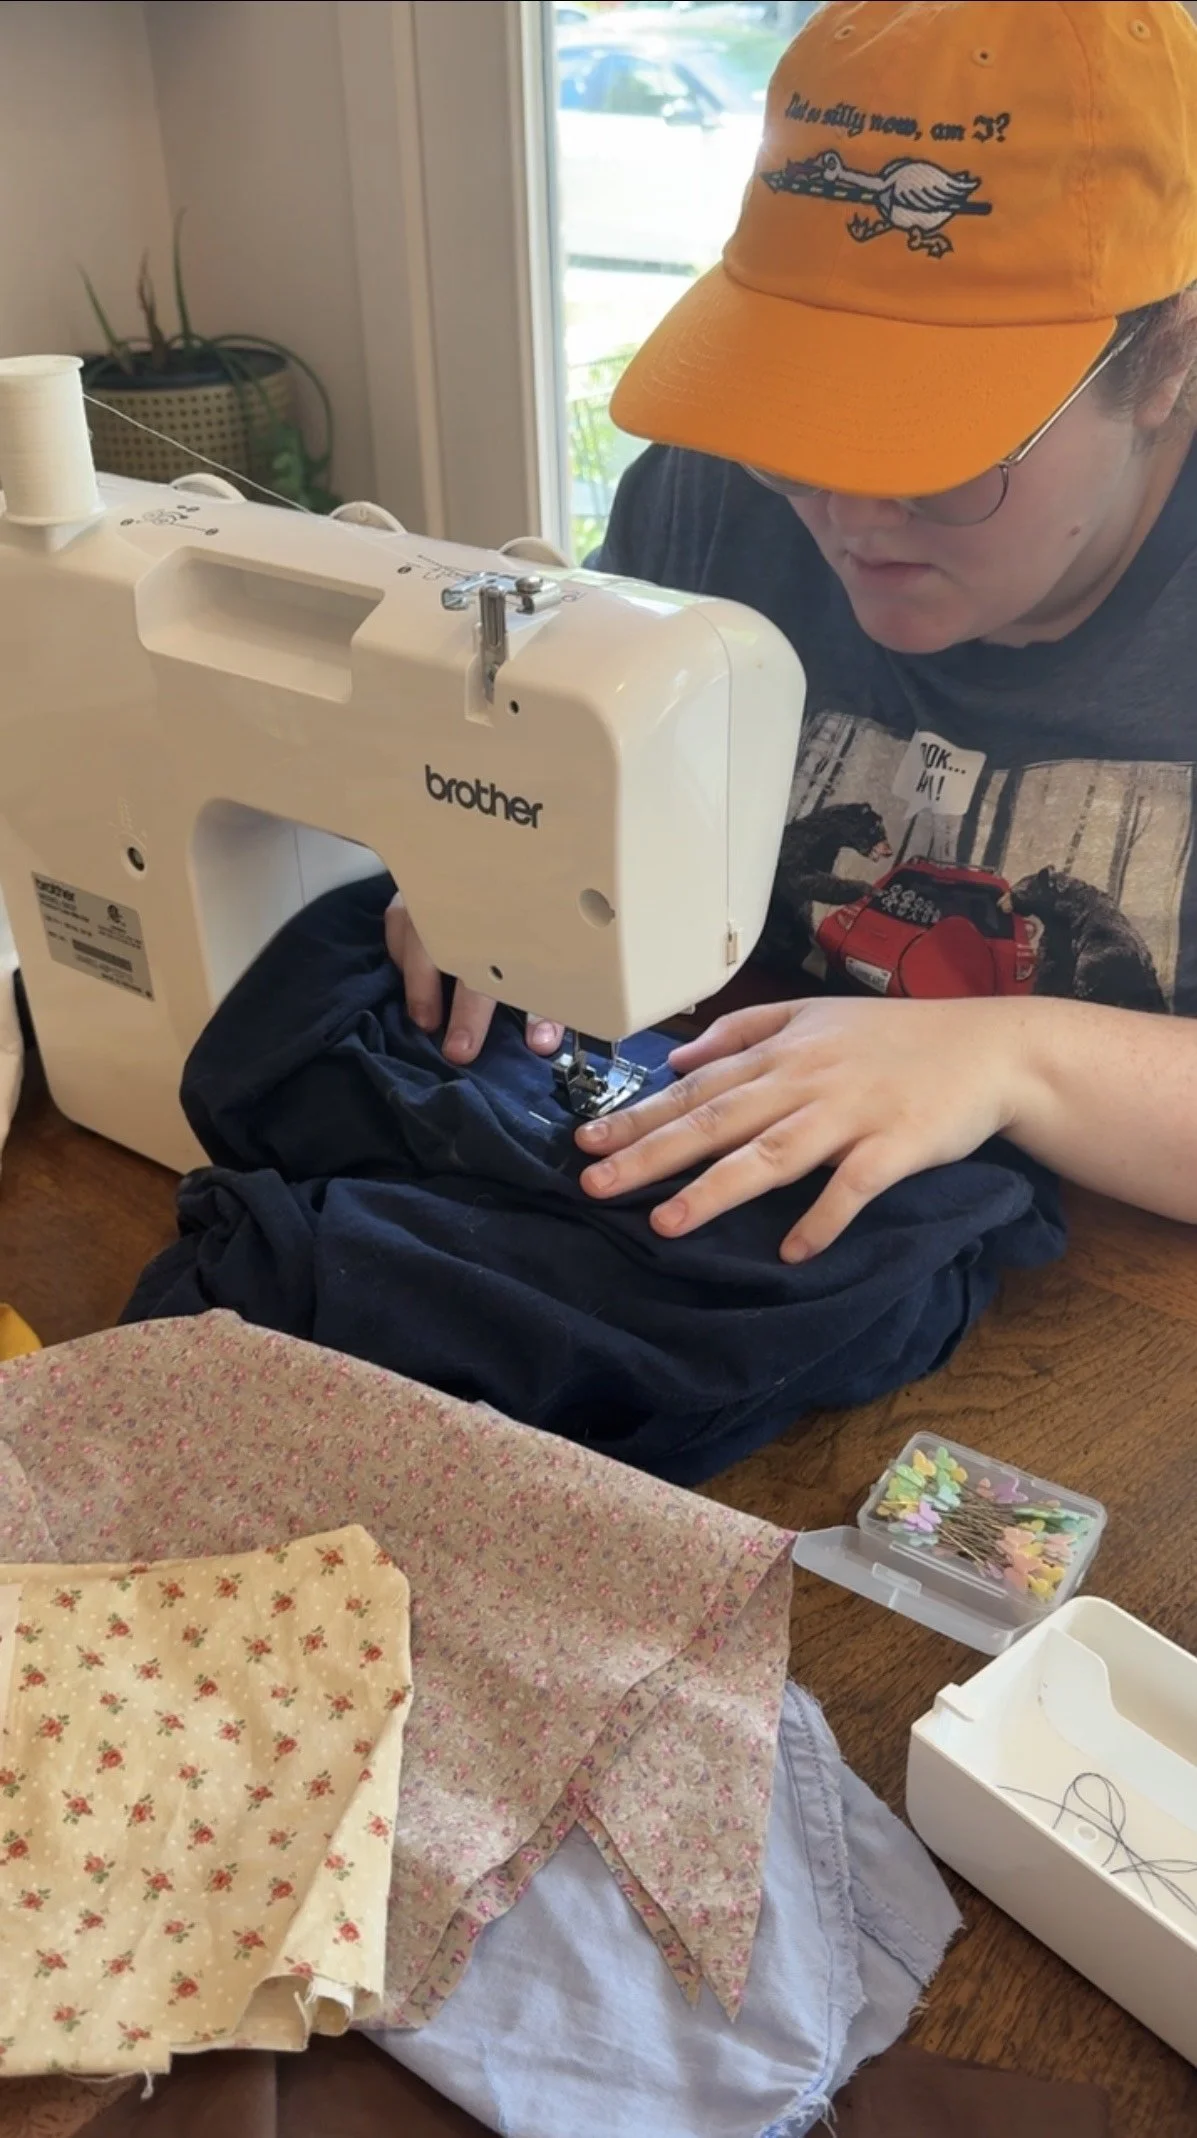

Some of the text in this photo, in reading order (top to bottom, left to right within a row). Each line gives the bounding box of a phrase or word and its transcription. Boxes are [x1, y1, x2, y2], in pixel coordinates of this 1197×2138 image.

[821, 102, 866, 138] silly
[869, 113, 922, 141] now,
[930, 123, 965, 141] am
[425, 763, 544, 829] brother
